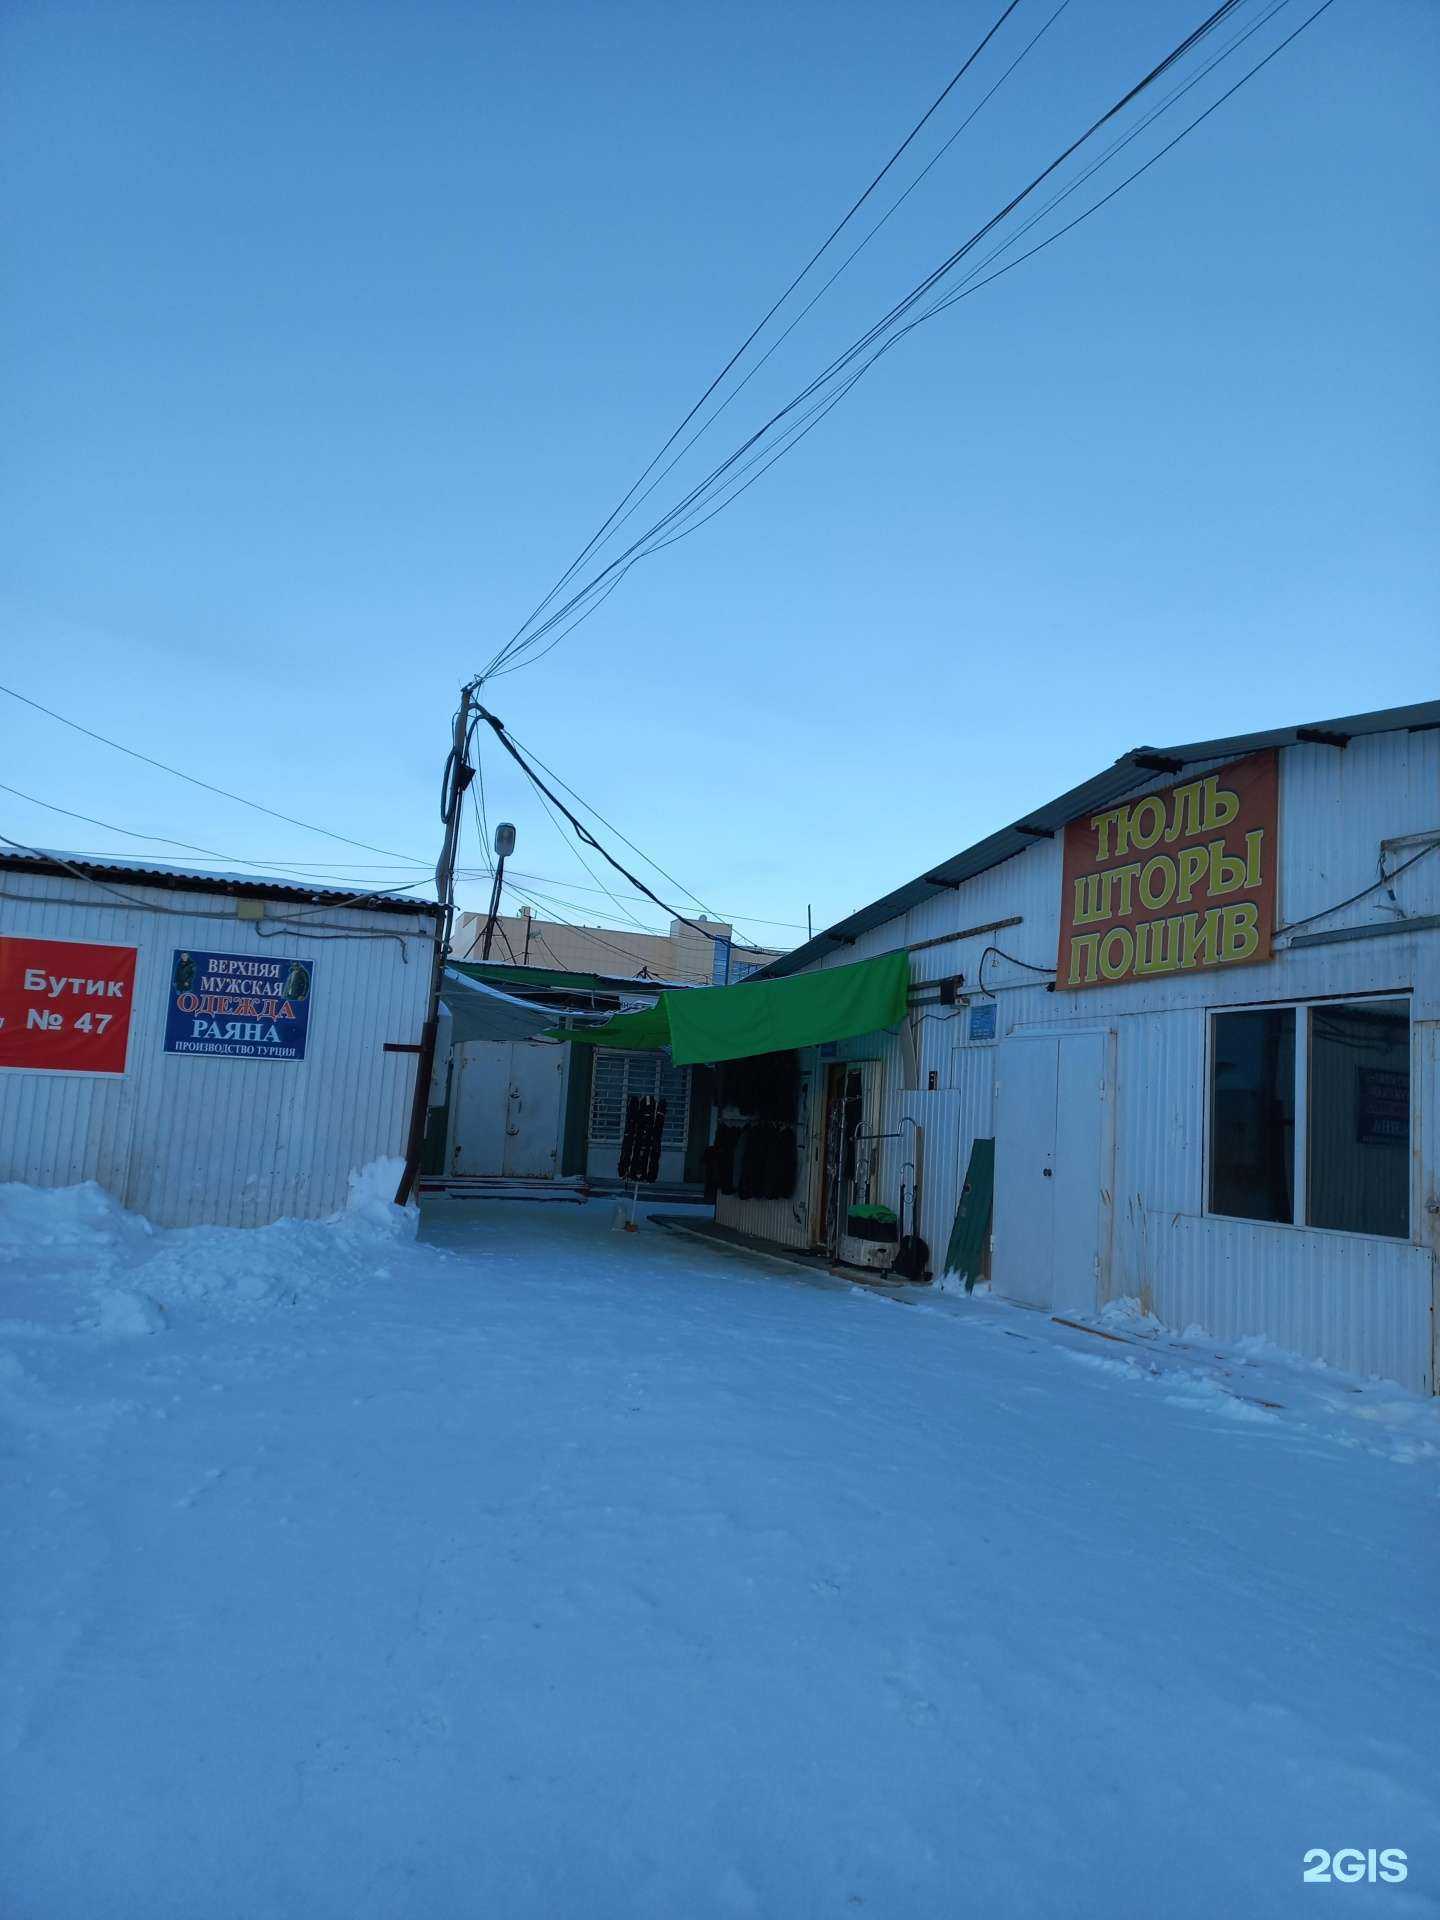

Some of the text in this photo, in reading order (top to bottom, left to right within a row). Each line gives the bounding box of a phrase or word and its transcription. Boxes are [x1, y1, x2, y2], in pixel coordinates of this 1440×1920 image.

[1091, 775, 1240, 862] ТЮЛЬ
[1072, 829, 1264, 926] ШТОРЫ
[1068, 902, 1260, 984] ПОШИВ
[207, 958, 281, 978] ВЕРХНЯЯ
[24, 968, 124, 997] Бутик
[200, 976, 284, 996] МУЖСКАЯ
[176, 992, 296, 1022] ОДЕЖДА
[26, 1008, 63, 1030] №
[74, 1012, 113, 1034] 47
[190, 1019, 281, 1043] РАЯНА
[175, 1041, 296, 1057] ПРОИЗВОДСТВО ТУРЦИЯ
